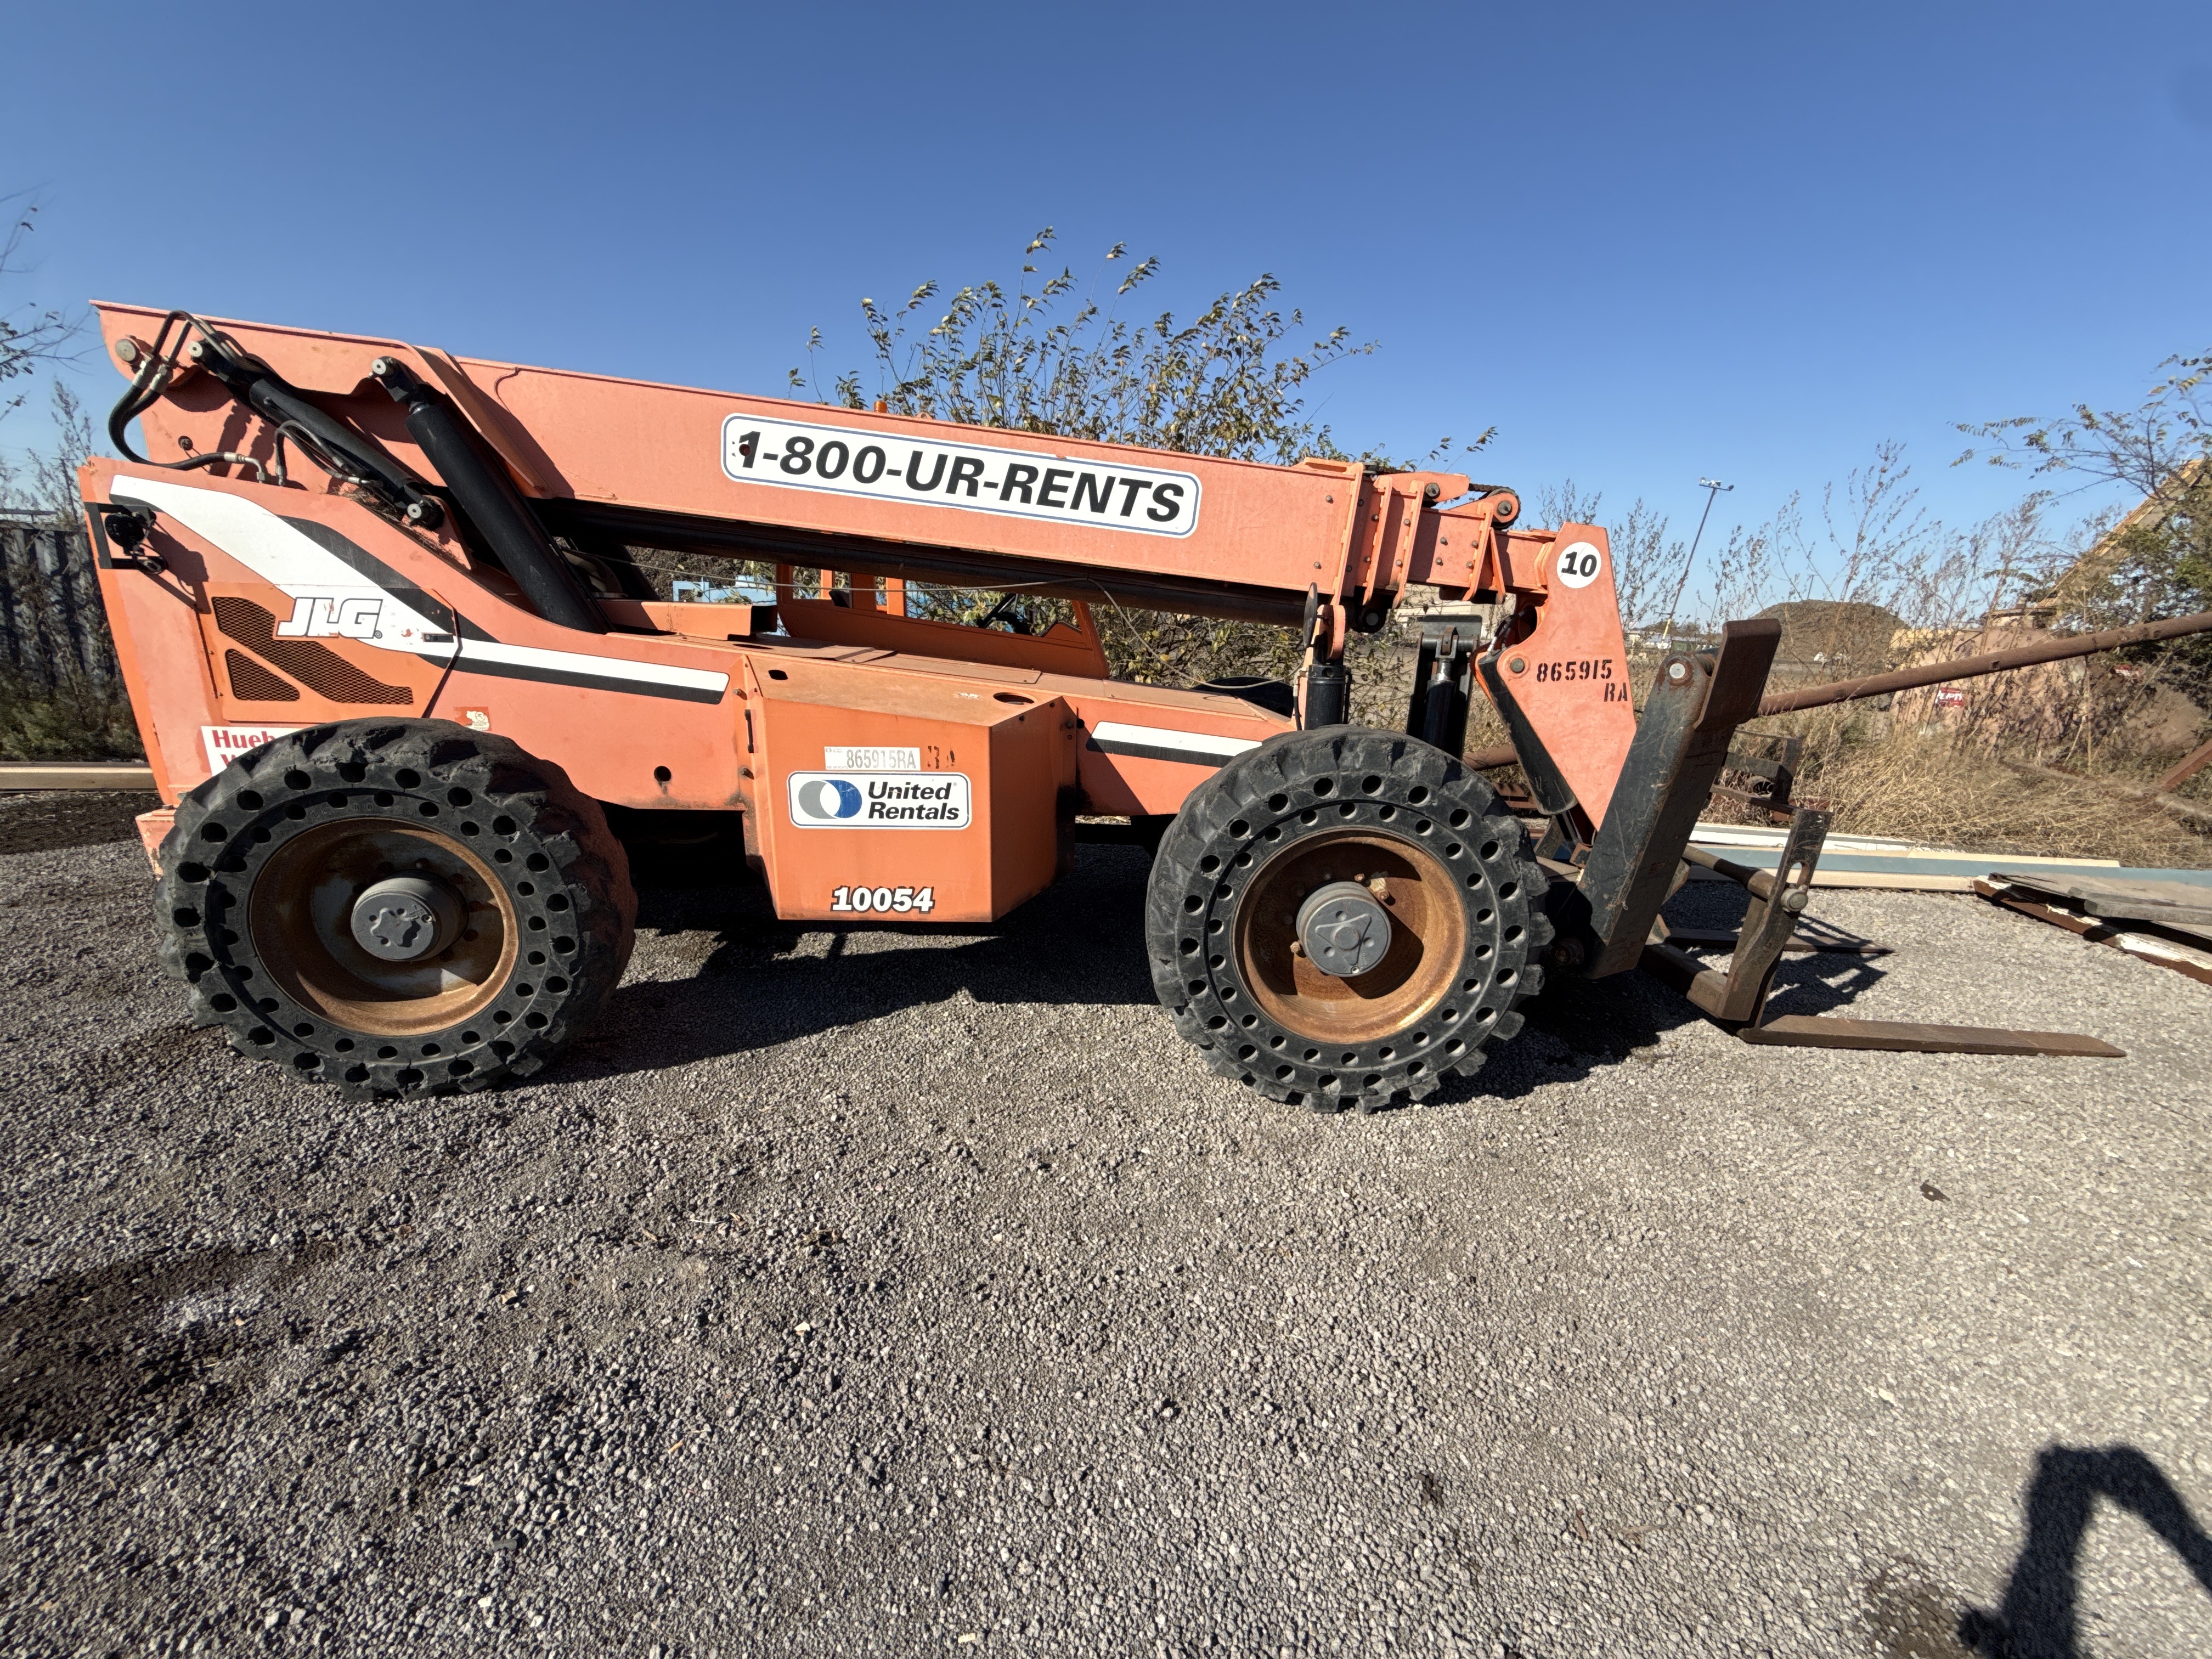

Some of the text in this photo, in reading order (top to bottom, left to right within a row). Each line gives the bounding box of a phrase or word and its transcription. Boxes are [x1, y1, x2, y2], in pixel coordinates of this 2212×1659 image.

[738, 431, 1184, 522] 1-800-UR-RENTS
[1561, 551, 1598, 578] 10
[275, 597, 383, 639] JLG
[1537, 659, 1612, 682] 865915
[1604, 682, 1628, 702] RA
[846, 749, 916, 769] 865915RA
[868, 781, 952, 800] United
[868, 802, 960, 820] Rentals
[831, 885, 935, 913] 10054
